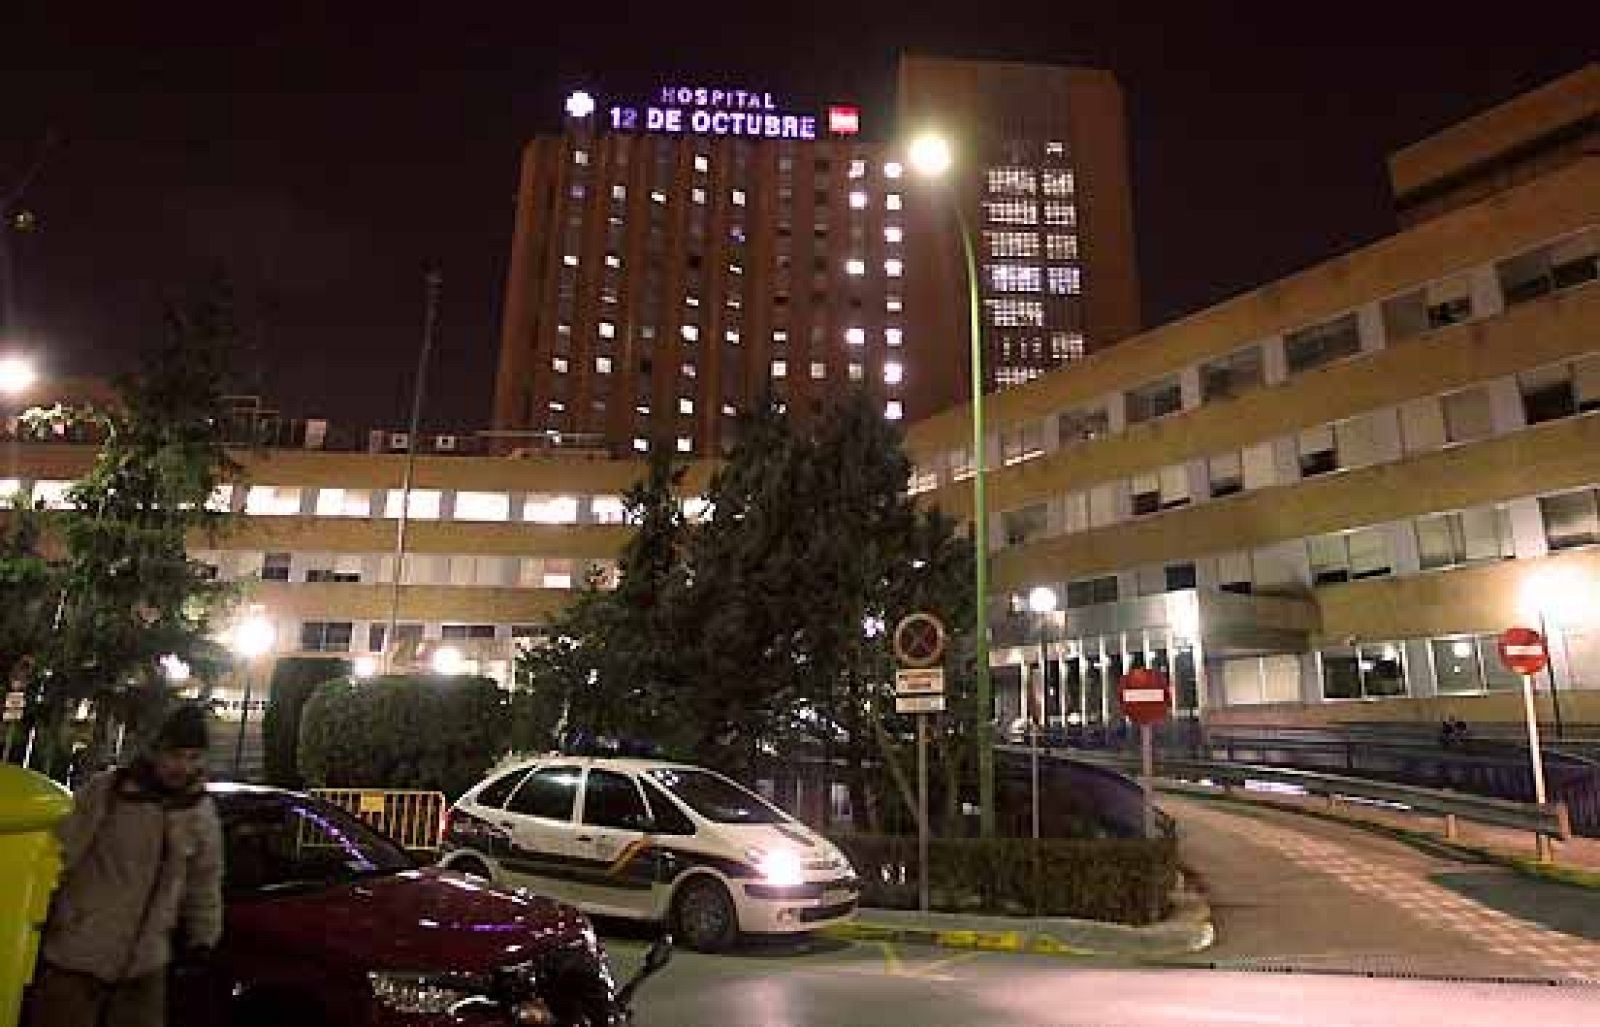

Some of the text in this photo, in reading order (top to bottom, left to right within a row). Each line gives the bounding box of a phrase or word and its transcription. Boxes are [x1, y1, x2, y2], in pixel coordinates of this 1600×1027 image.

[661, 86, 777, 109] HOSPITAL
[610, 106, 638, 129] 12
[646, 107, 682, 132] DE
[692, 110, 816, 139] OCTUBRE
